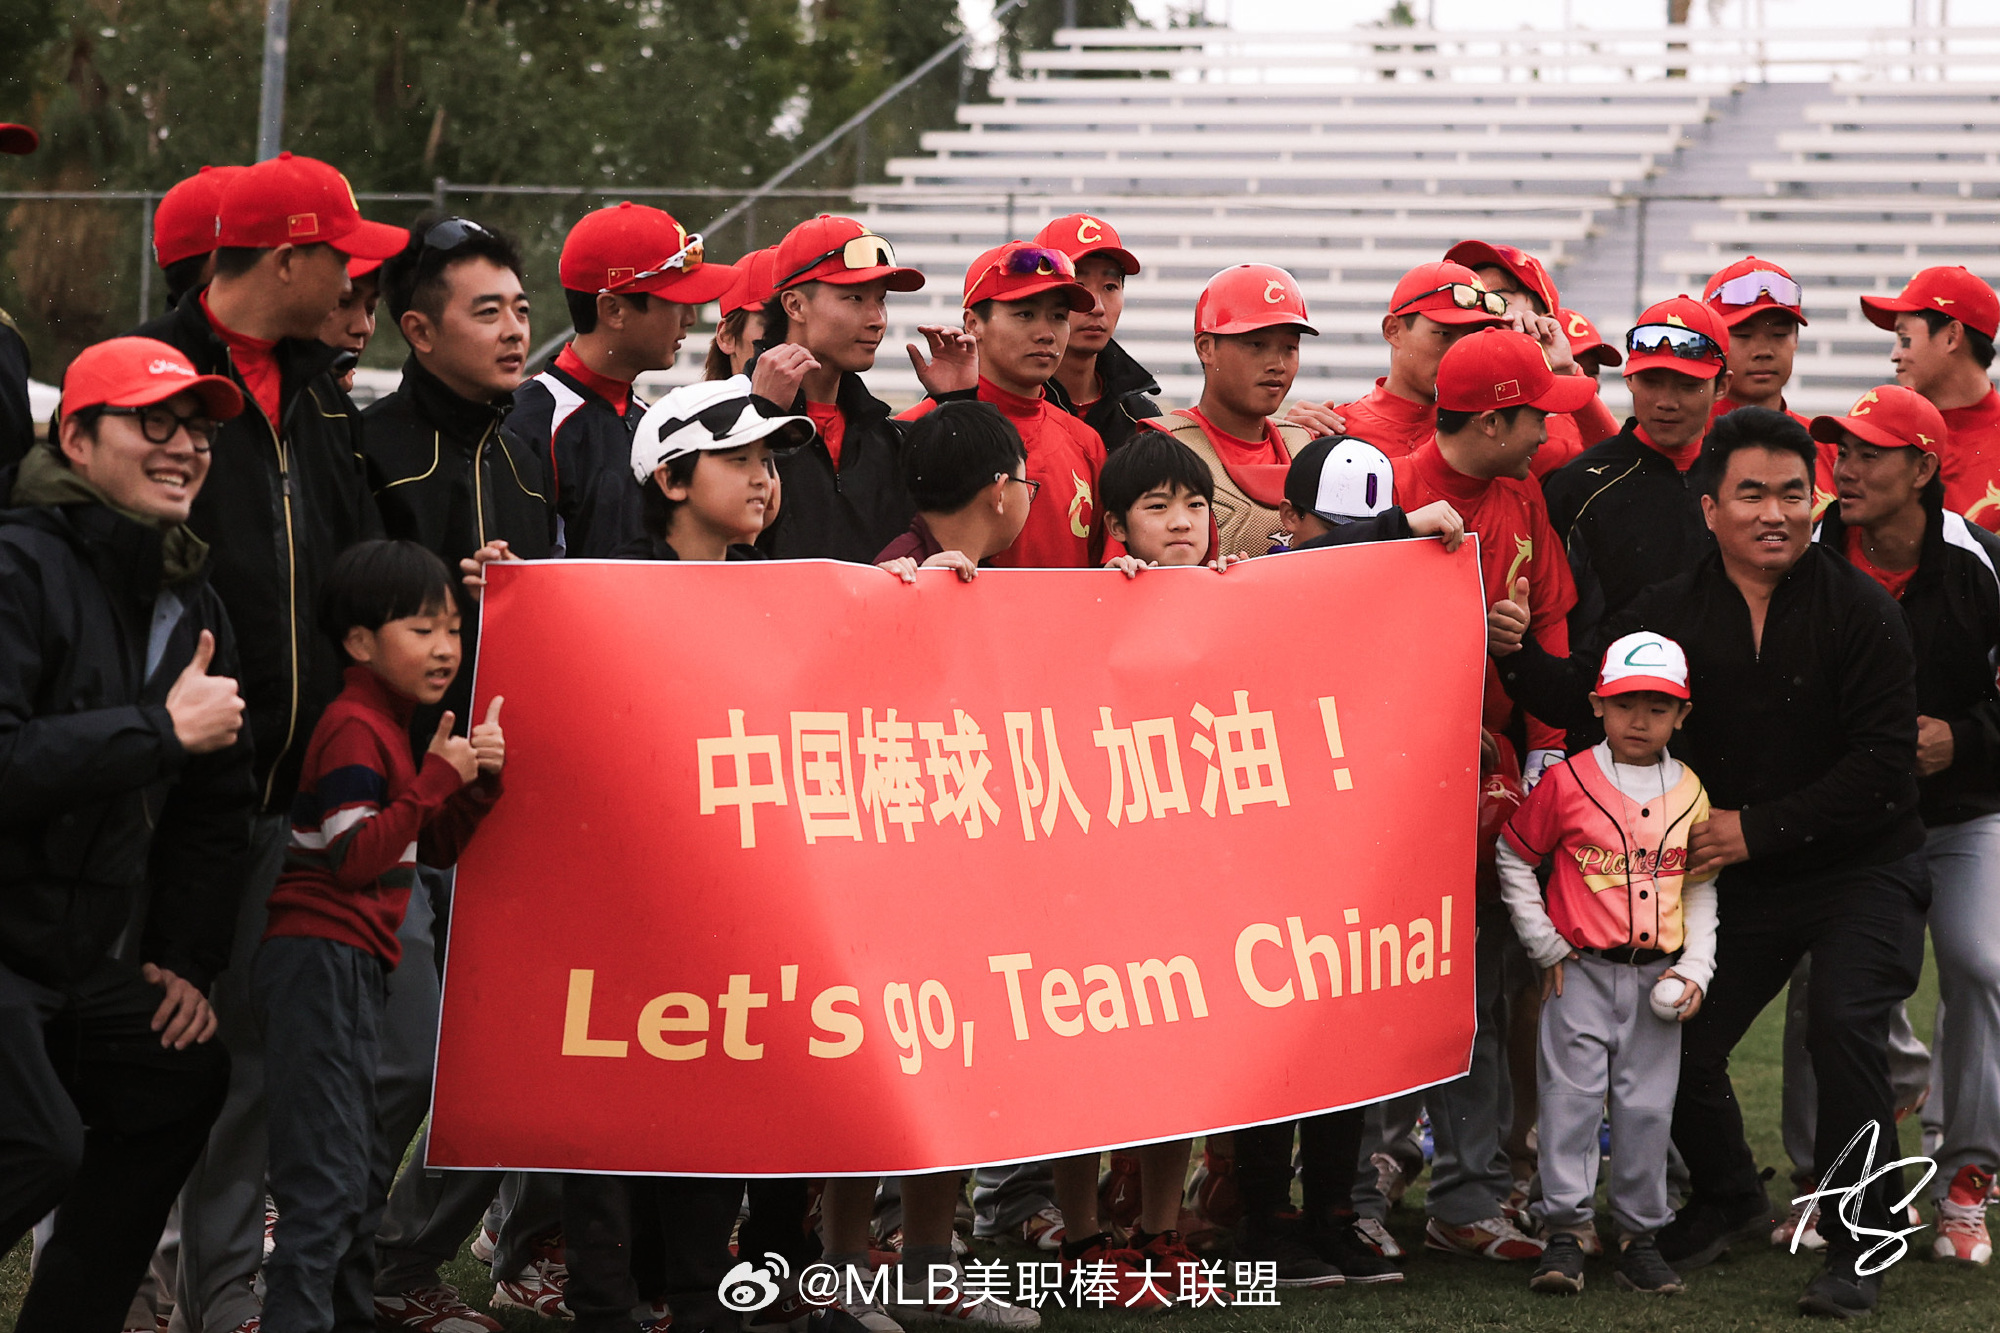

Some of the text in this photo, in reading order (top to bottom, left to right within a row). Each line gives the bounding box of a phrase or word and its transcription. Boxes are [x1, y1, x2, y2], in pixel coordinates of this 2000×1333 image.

[696, 690, 1354, 849] 中国棒球队加油！
[561, 895, 1453, 1076] Let's go, Team China!
